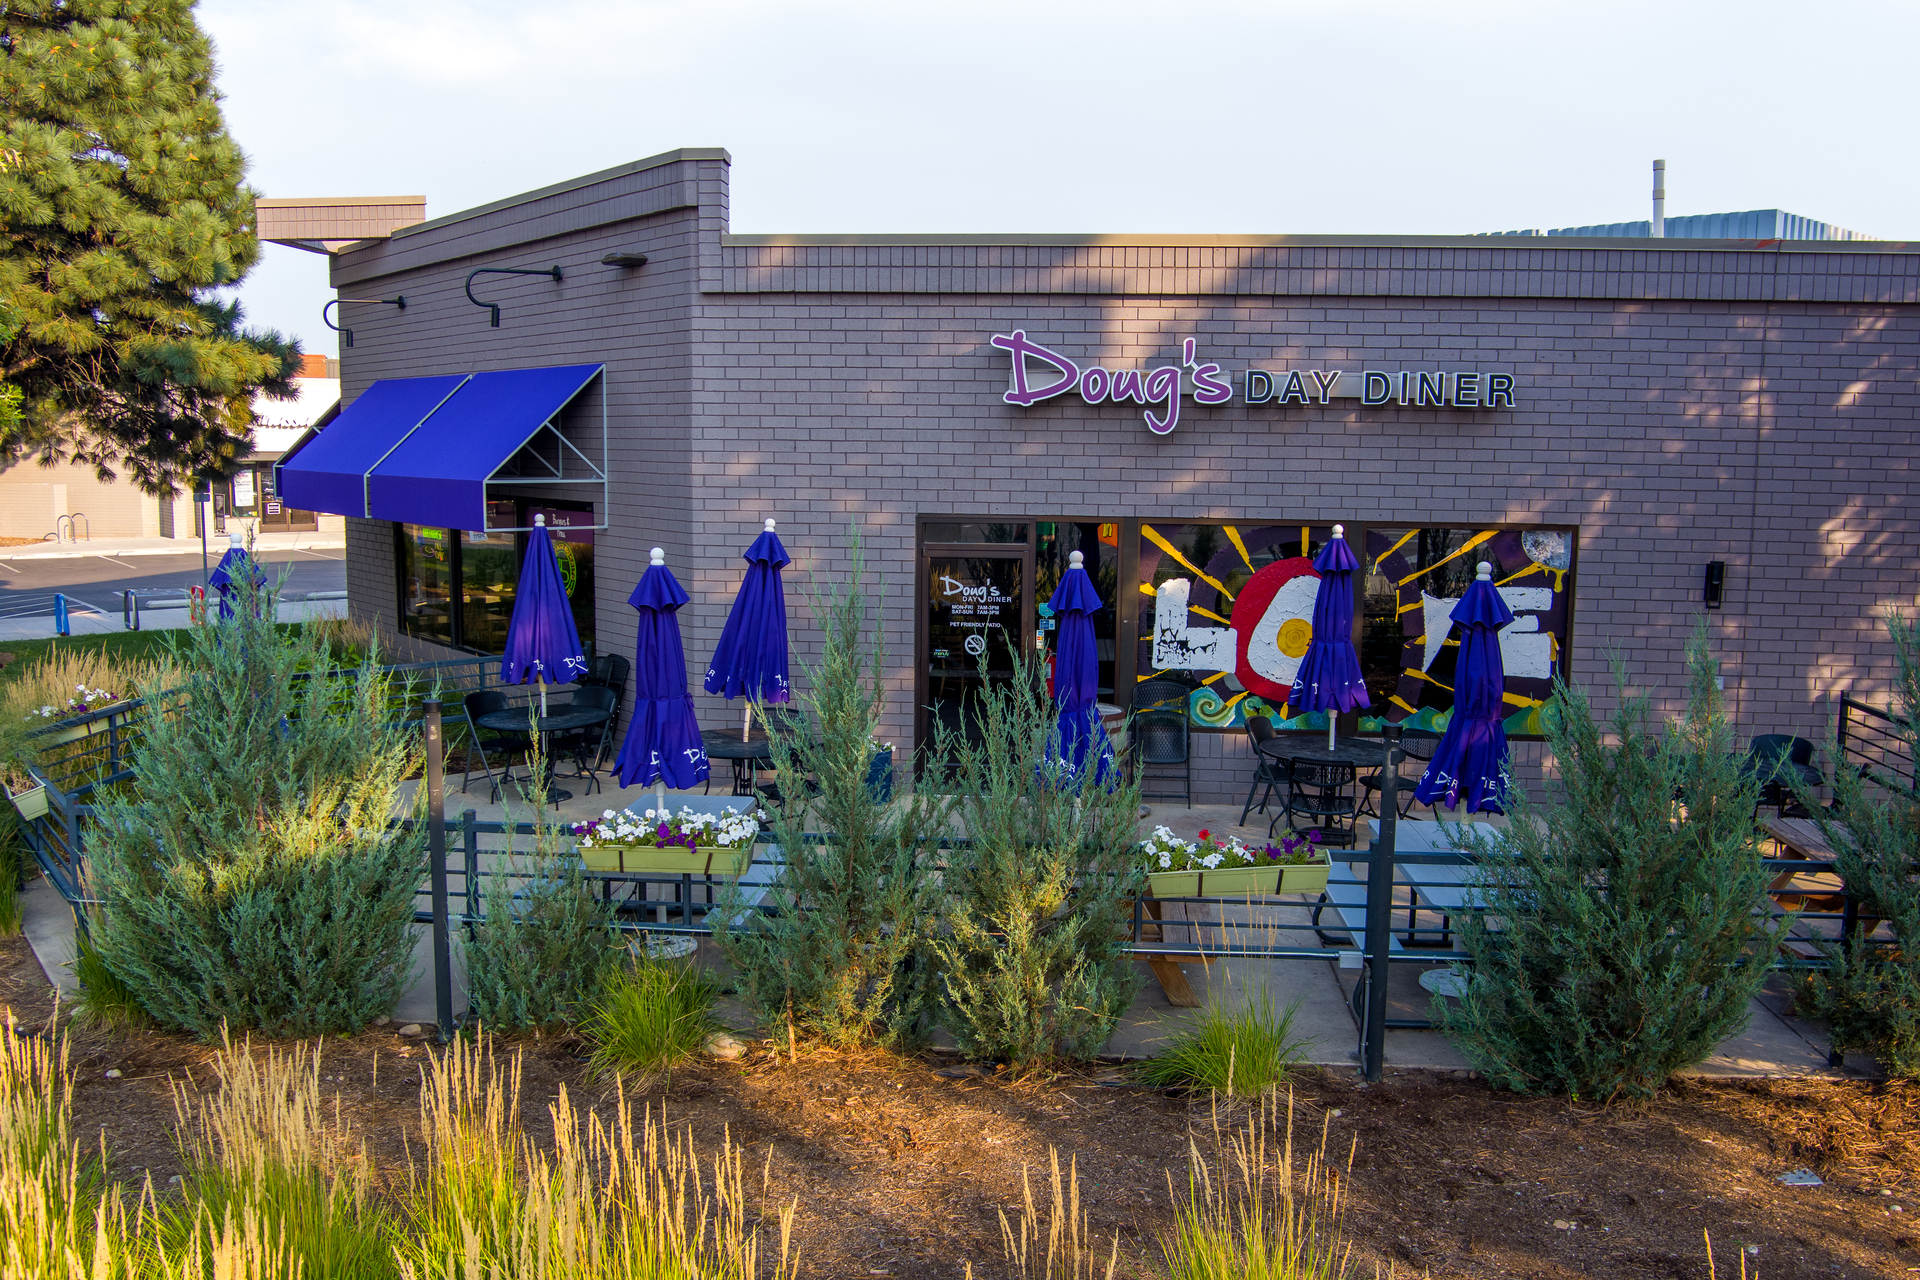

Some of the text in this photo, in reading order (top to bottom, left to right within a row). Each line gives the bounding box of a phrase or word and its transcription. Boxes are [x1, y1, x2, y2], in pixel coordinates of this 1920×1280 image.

[990, 329, 1516, 434] Doug's DAY DINER
[939, 575, 1001, 603] Doug's
